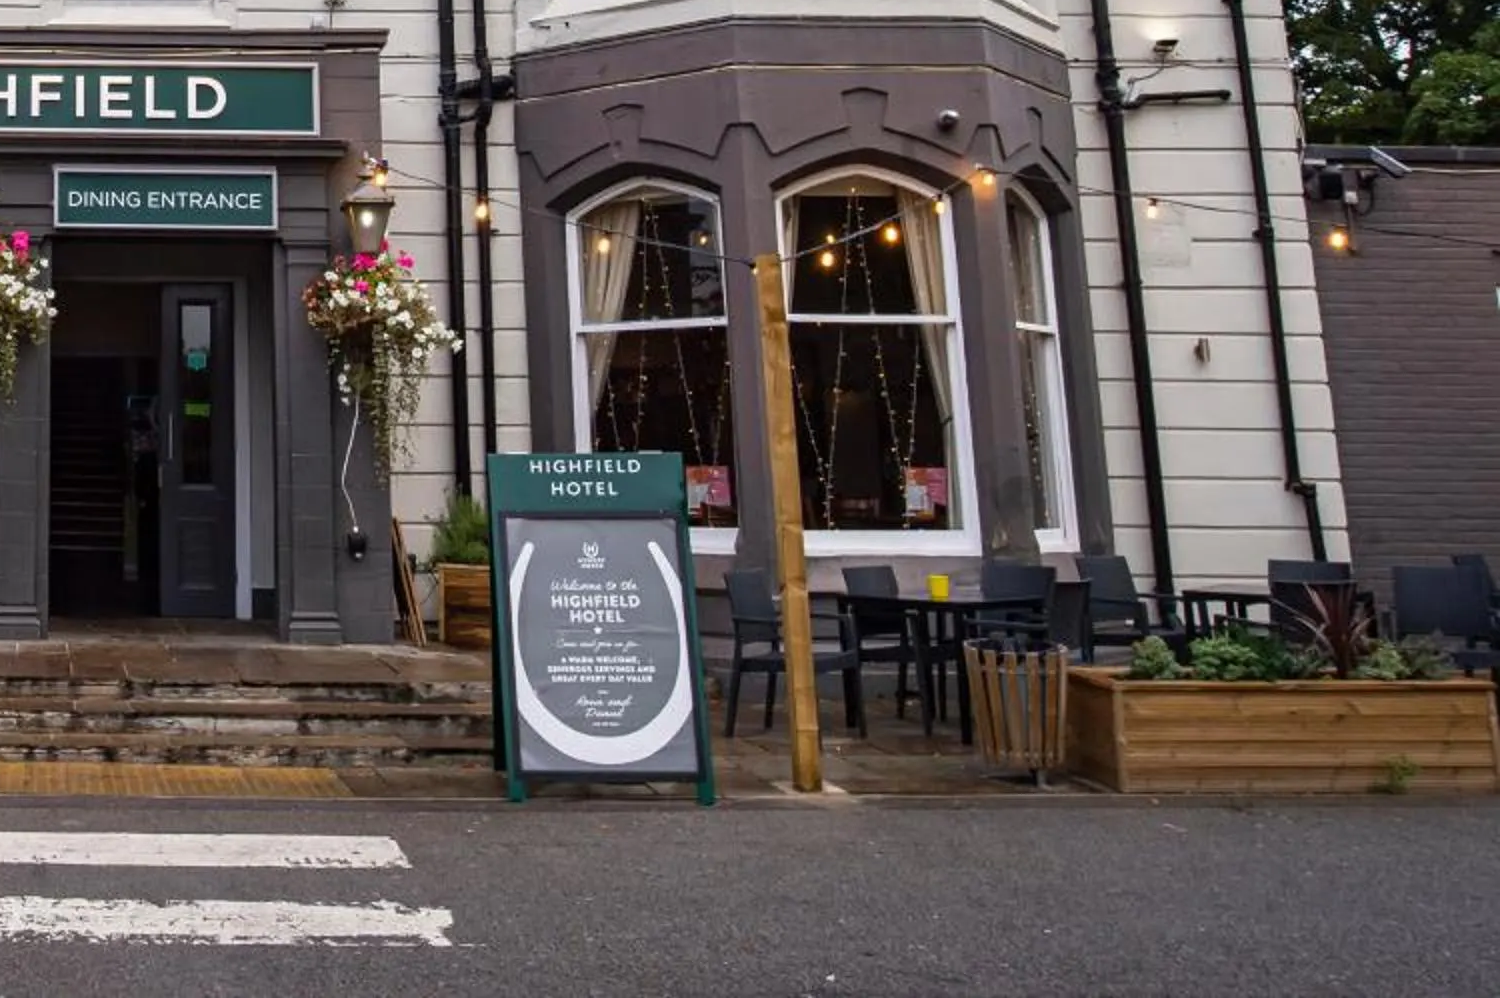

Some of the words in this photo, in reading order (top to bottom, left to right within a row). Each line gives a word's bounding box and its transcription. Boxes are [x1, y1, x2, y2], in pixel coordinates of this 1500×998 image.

[67, 190, 142, 208] DINING
[147, 192, 263, 210] ENTRANCE
[528, 459, 641, 474] HIGHFIELD
[551, 481, 619, 496] HOTEL
[550, 595, 641, 608] HIGHFIELD
[569, 609, 625, 623] HOTEL
